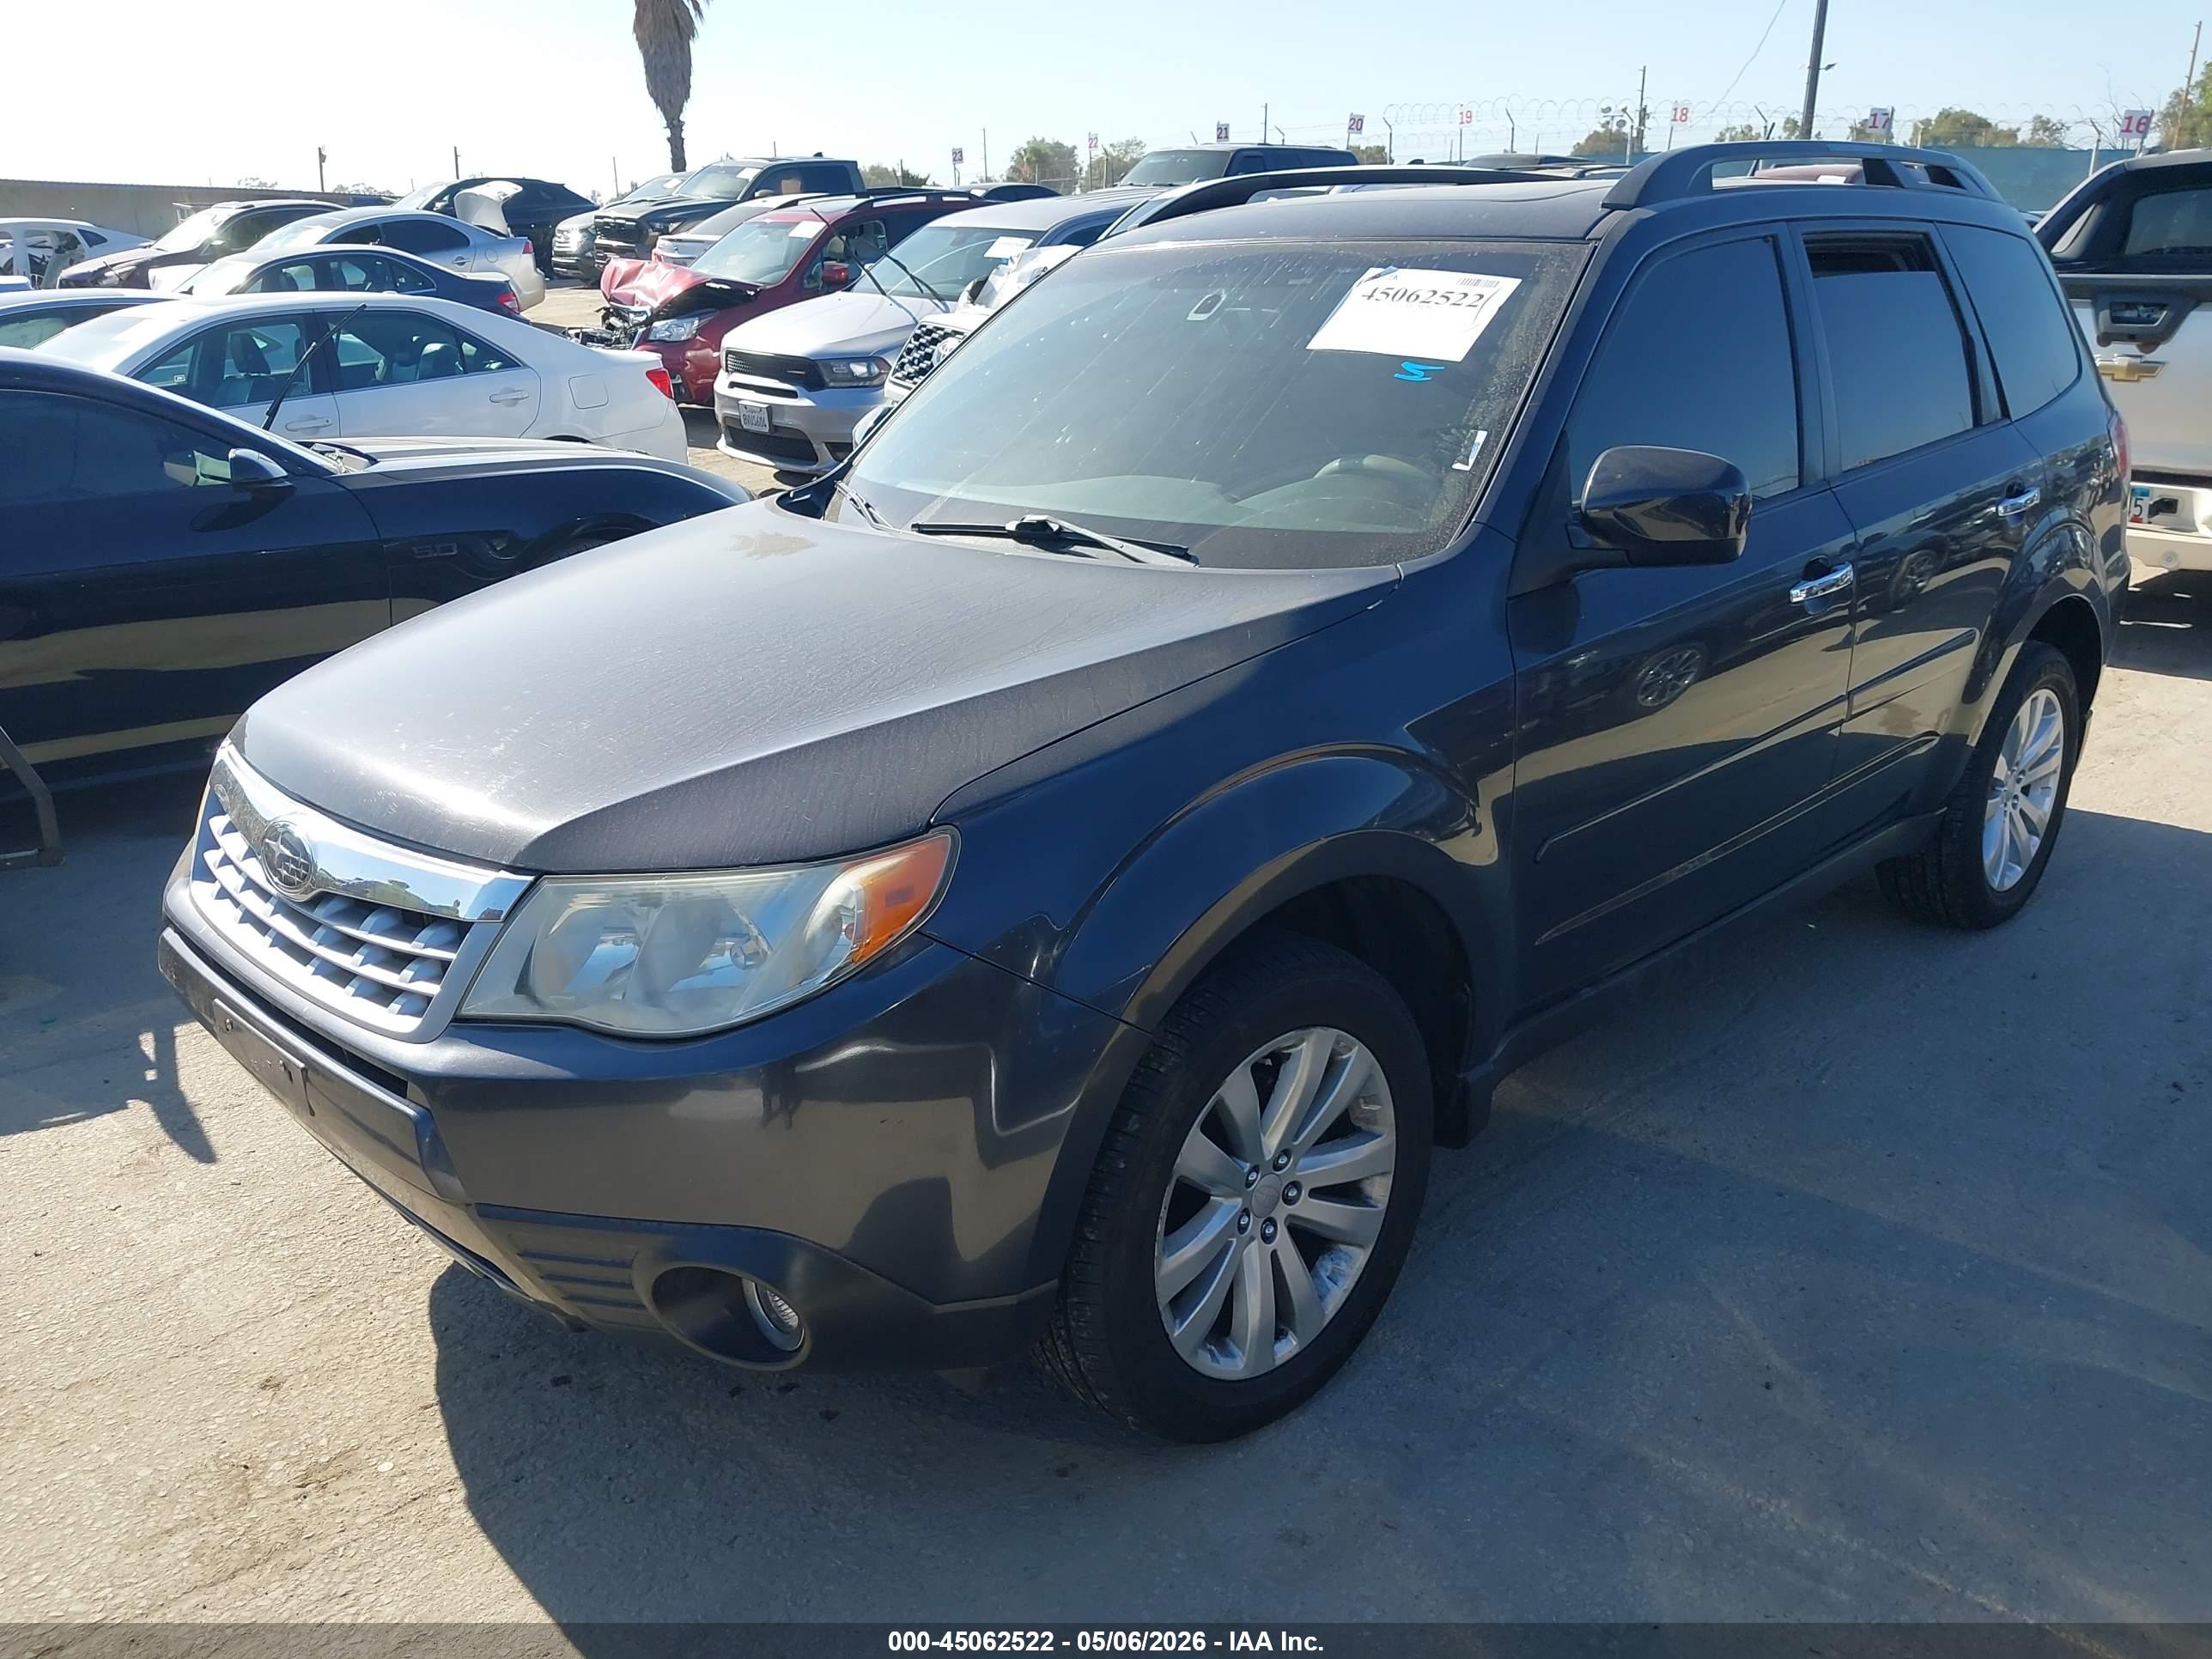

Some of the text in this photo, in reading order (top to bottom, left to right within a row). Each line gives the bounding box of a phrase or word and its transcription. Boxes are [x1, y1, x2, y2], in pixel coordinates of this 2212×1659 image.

[1459, 110, 1472, 125] 19
[1671, 106, 1689, 122] 18
[1868, 112, 1889, 129] 17
[1348, 117, 1363, 131] 20
[2120, 115, 2149, 133] 16
[1216, 126, 1230, 139] 21
[1088, 137, 1098, 149] 22
[952, 150, 963, 162] 23
[1361, 287, 1485, 308] 45062522
[412, 543, 458, 558] 5.0
